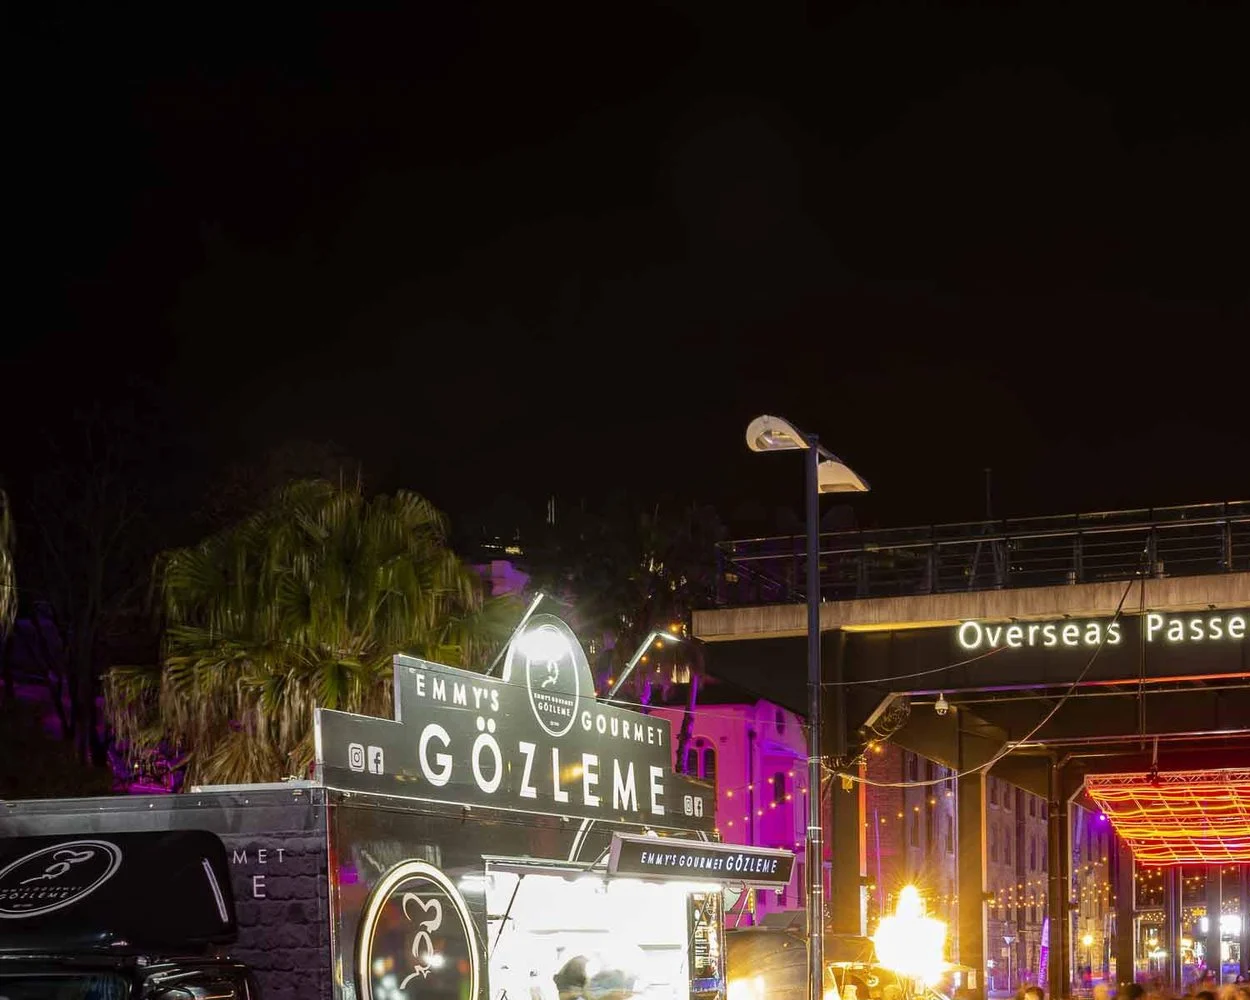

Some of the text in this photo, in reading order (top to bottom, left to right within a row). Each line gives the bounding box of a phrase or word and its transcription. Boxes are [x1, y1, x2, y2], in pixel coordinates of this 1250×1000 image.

[958, 619, 1122, 650] Overseas
[415, 673, 500, 712] EMMY'S
[581, 710, 664, 747] GOURMET
[418, 715, 666, 816] GÖZLEME
[640, 851, 778, 874] EMMY'S GOURMET GÖZLEME
